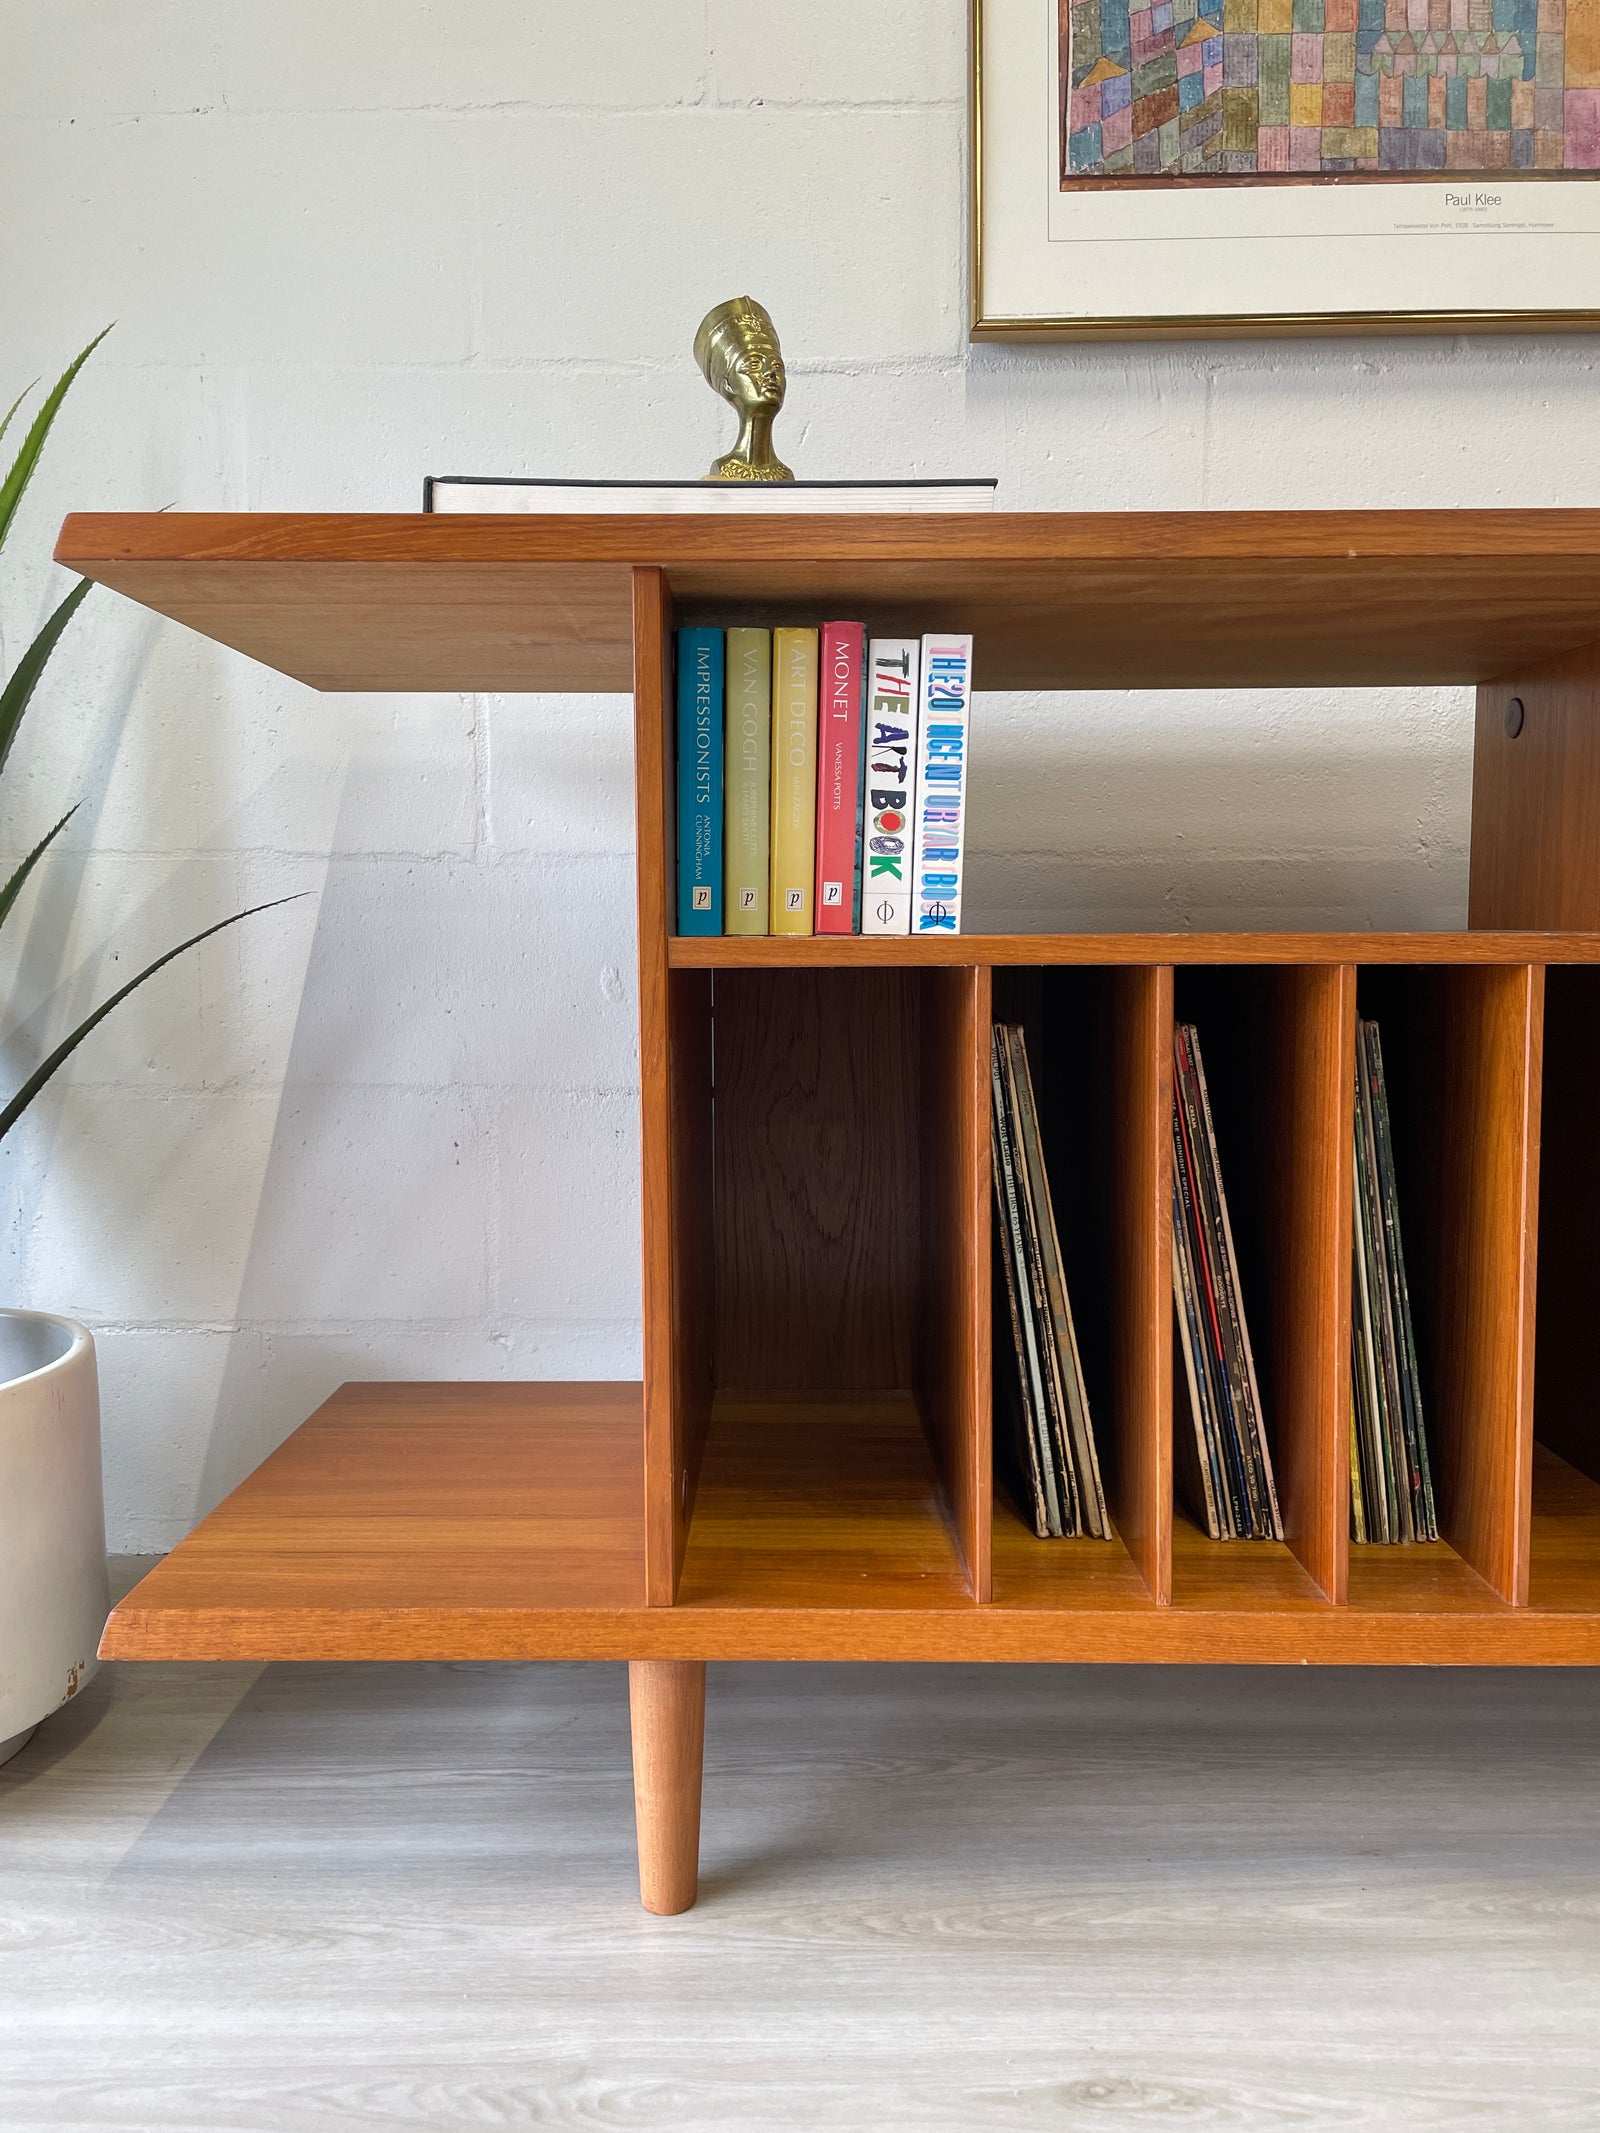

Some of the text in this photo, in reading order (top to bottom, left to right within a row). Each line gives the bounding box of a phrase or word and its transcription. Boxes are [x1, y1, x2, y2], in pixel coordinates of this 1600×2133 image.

[1445, 193, 1501, 206] Paul Klee
[743, 649, 757, 771] VAN GOGH
[790, 649, 805, 766] ART DECO
[833, 642, 850, 722] MONET
[697, 646, 710, 802] IMPRESSIONISTS
[833, 742, 843, 810] VANESSA POTTS
[870, 649, 911, 881] THE ART BOOK
[695, 815, 703, 880] CUNNINGHAM
[1021, 1089, 1029, 1116] CHICAGO
[1176, 1135, 1185, 1173] MIDNIGHT
[1182, 1176, 1190, 1209] SPECIAL
[1217, 1275, 1226, 1309] GOODBYE
